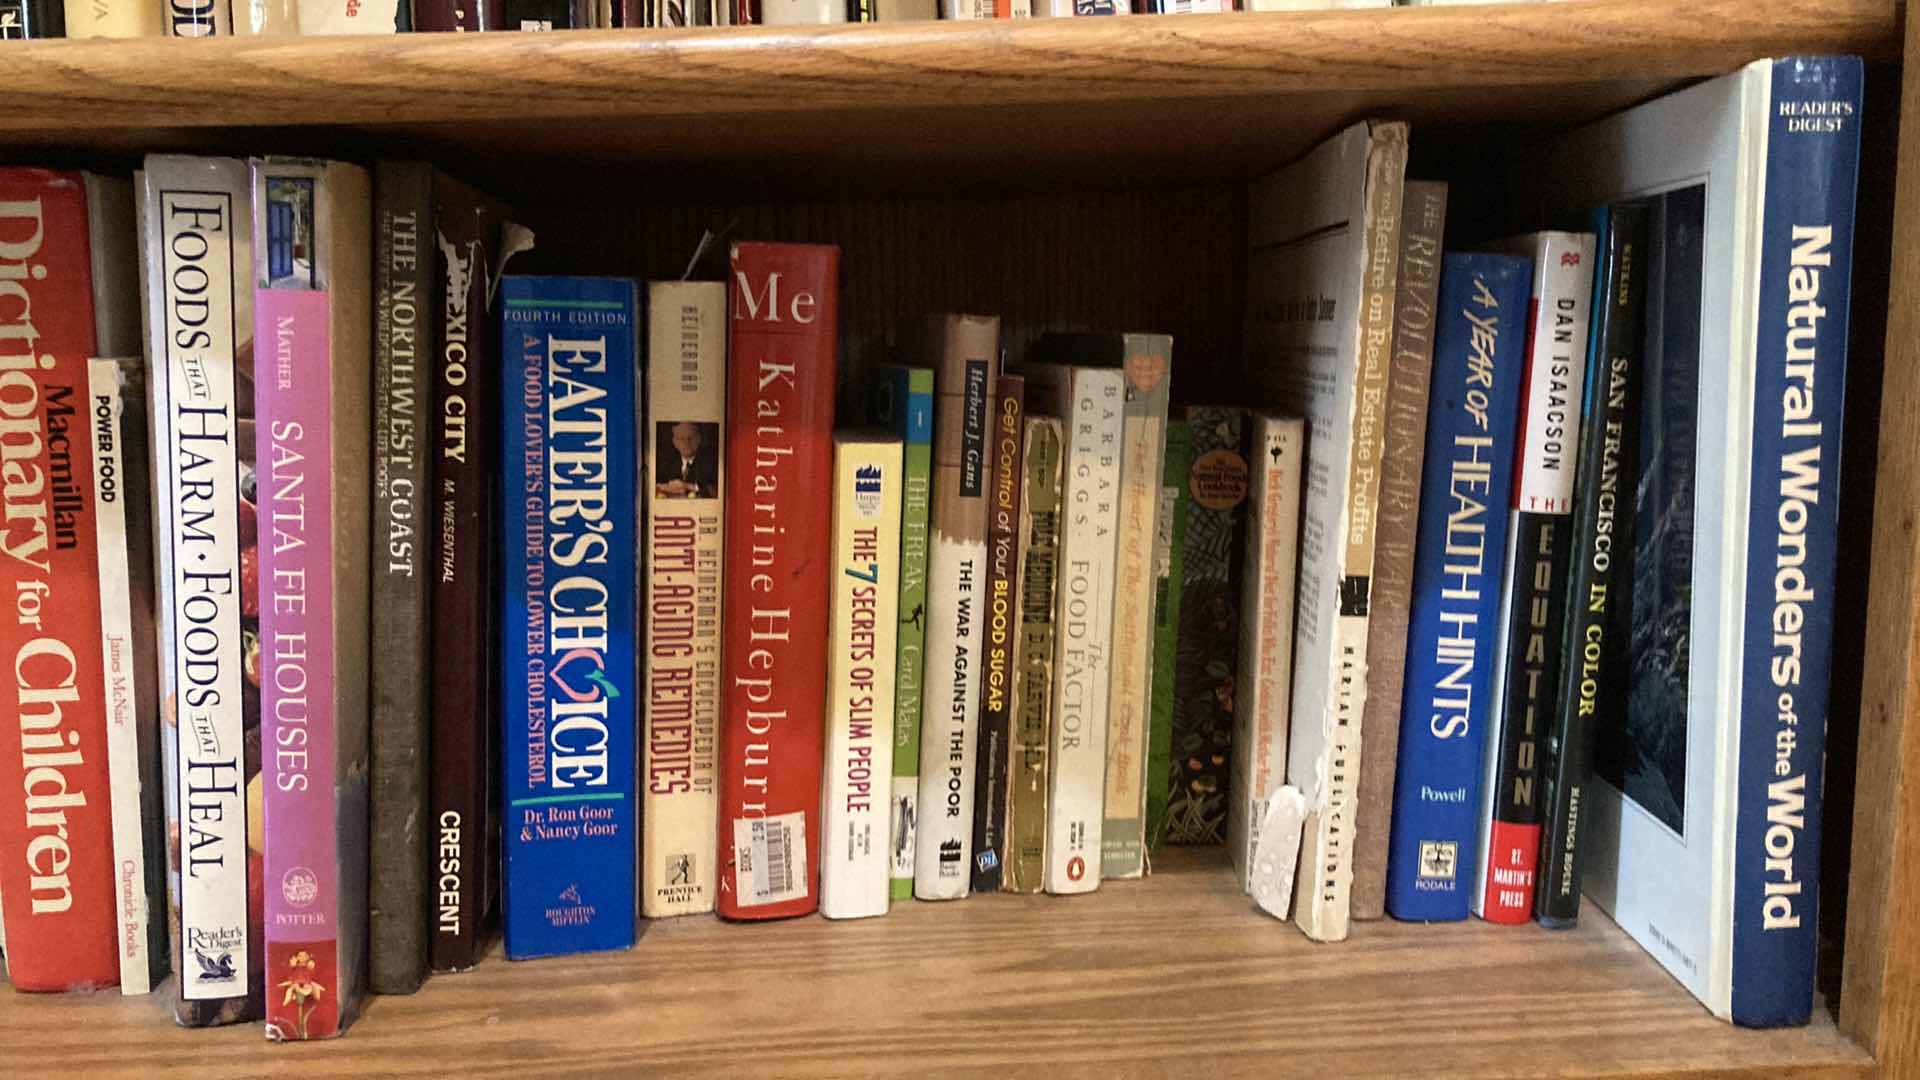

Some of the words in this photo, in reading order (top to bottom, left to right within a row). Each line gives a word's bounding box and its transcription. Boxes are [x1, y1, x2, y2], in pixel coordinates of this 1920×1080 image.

[1779, 101, 1853, 115] READER'S
[1787, 117, 1845, 132] DIGEST
[392, 210, 417, 272] THE
[1370, 215, 1395, 289] Retire
[171, 202, 222, 351] FOODS
[735, 271, 818, 324] Me
[1473, 275, 1498, 309] A
[503, 310, 561, 323] FOURTH
[569, 311, 628, 325] EDITION
[1369, 293, 1385, 321] on
[1554, 299, 1575, 344] DAN
[1781, 222, 1833, 439] Natural
[278, 316, 295, 391] MATHER
[523, 335, 541, 348] A
[1363, 326, 1386, 381] Real
[1463, 309, 1499, 388] YEAR
[0, 197, 57, 576] Dictionary
[186, 357, 207, 399] THAT
[391, 281, 416, 470] NORTHWEST
[523, 354, 543, 414] FOOD
[969, 367, 984, 430] Herbert
[1608, 358, 1629, 409] SAN
[96, 395, 113, 453] POWER
[445, 395, 467, 464] CITY
[965, 430, 981, 447] J.
[1003, 397, 1018, 436] Get
[1357, 386, 1381, 461] Estate
[1464, 390, 1489, 431] OF
[1542, 355, 1571, 470] ISAACSON
[44, 383, 84, 551] Macmillan
[98, 456, 117, 503] FOOD
[177, 401, 229, 546] HARM
[524, 414, 545, 493] LOVER'S
[548, 333, 612, 567] EATER'S
[751, 360, 796, 593] Katharine
[966, 449, 980, 489] Gans
[999, 438, 1016, 510] Control
[1075, 397, 1094, 526] GRIGGS
[1096, 384, 1118, 537] BARBARA
[271, 420, 306, 557] SANTA
[908, 477, 926, 512] THE
[1351, 465, 1375, 546] Profits
[1441, 436, 1494, 600] HEALTH
[1530, 497, 1568, 511] THE
[1592, 420, 1623, 573] FRANCISCO
[389, 477, 415, 577] COAST
[443, 499, 456, 584] WIESENTHAL
[526, 497, 545, 559] GUIDE
[853, 526, 877, 562] THE
[997, 513, 1013, 535] of
[526, 561, 545, 586] TO
[652, 515, 696, 658] ANTI-AGING
[845, 564, 878, 585] 7
[903, 523, 925, 592] FREAK
[959, 560, 973, 592] THE
[994, 536, 1011, 578] Your
[1770, 443, 1821, 686] Wonders
[15, 579, 51, 631] for
[274, 566, 306, 617] FE
[956, 597, 972, 638] WAR
[991, 579, 1009, 645] BLOOD
[1067, 560, 1090, 639] FOOD
[1589, 583, 1607, 613] IN
[182, 566, 233, 708] FOODS
[526, 589, 546, 655] LOWER
[850, 586, 876, 661] SECRETS
[105, 634, 124, 673] James
[850, 667, 873, 691] OF
[988, 649, 1006, 713] SUGAR
[1087, 643, 1103, 671] The
[1430, 612, 1479, 739] HINTS
[1579, 623, 1604, 718] COLOR
[110, 674, 126, 727] McNair
[274, 631, 309, 794] HOUSES
[735, 606, 792, 819] Hepburn
[951, 645, 968, 723] AGAINST
[1062, 649, 1085, 750] FACTOR
[1776, 692, 1798, 725] of
[197, 716, 216, 755] THAT
[527, 660, 546, 789] CHOLESTEROL
[650, 666, 693, 795] REMEDIES
[848, 697, 873, 740] SLIM
[949, 729, 964, 761] THE
[14, 637, 88, 916] Children
[847, 746, 872, 813] PEOPLE
[1774, 727, 1797, 776] the
[549, 807, 577, 822] Ron
[580, 805, 614, 820] Goor
[694, 778, 713, 794] OF
[946, 767, 962, 818] POOR
[1421, 786, 1466, 803] Powell
[187, 755, 238, 878] HEAL
[520, 826, 533, 842] &
[536, 822, 580, 840] Nancy
[583, 820, 618, 837] Goor
[1324, 744, 1347, 901] PUBLICATIONS
[439, 810, 461, 935] CRESCENT
[1494, 868, 1532, 886] MARTIN'S
[1762, 773, 1807, 931] World
[657, 886, 703, 897] PRENTICE
[667, 895, 693, 904] HALL
[1416, 880, 1456, 891] RODALE
[1500, 891, 1524, 907] PRESS
[125, 920, 139, 959] Books
[188, 926, 242, 948] Reader's
[276, 912, 326, 925] POTTER
